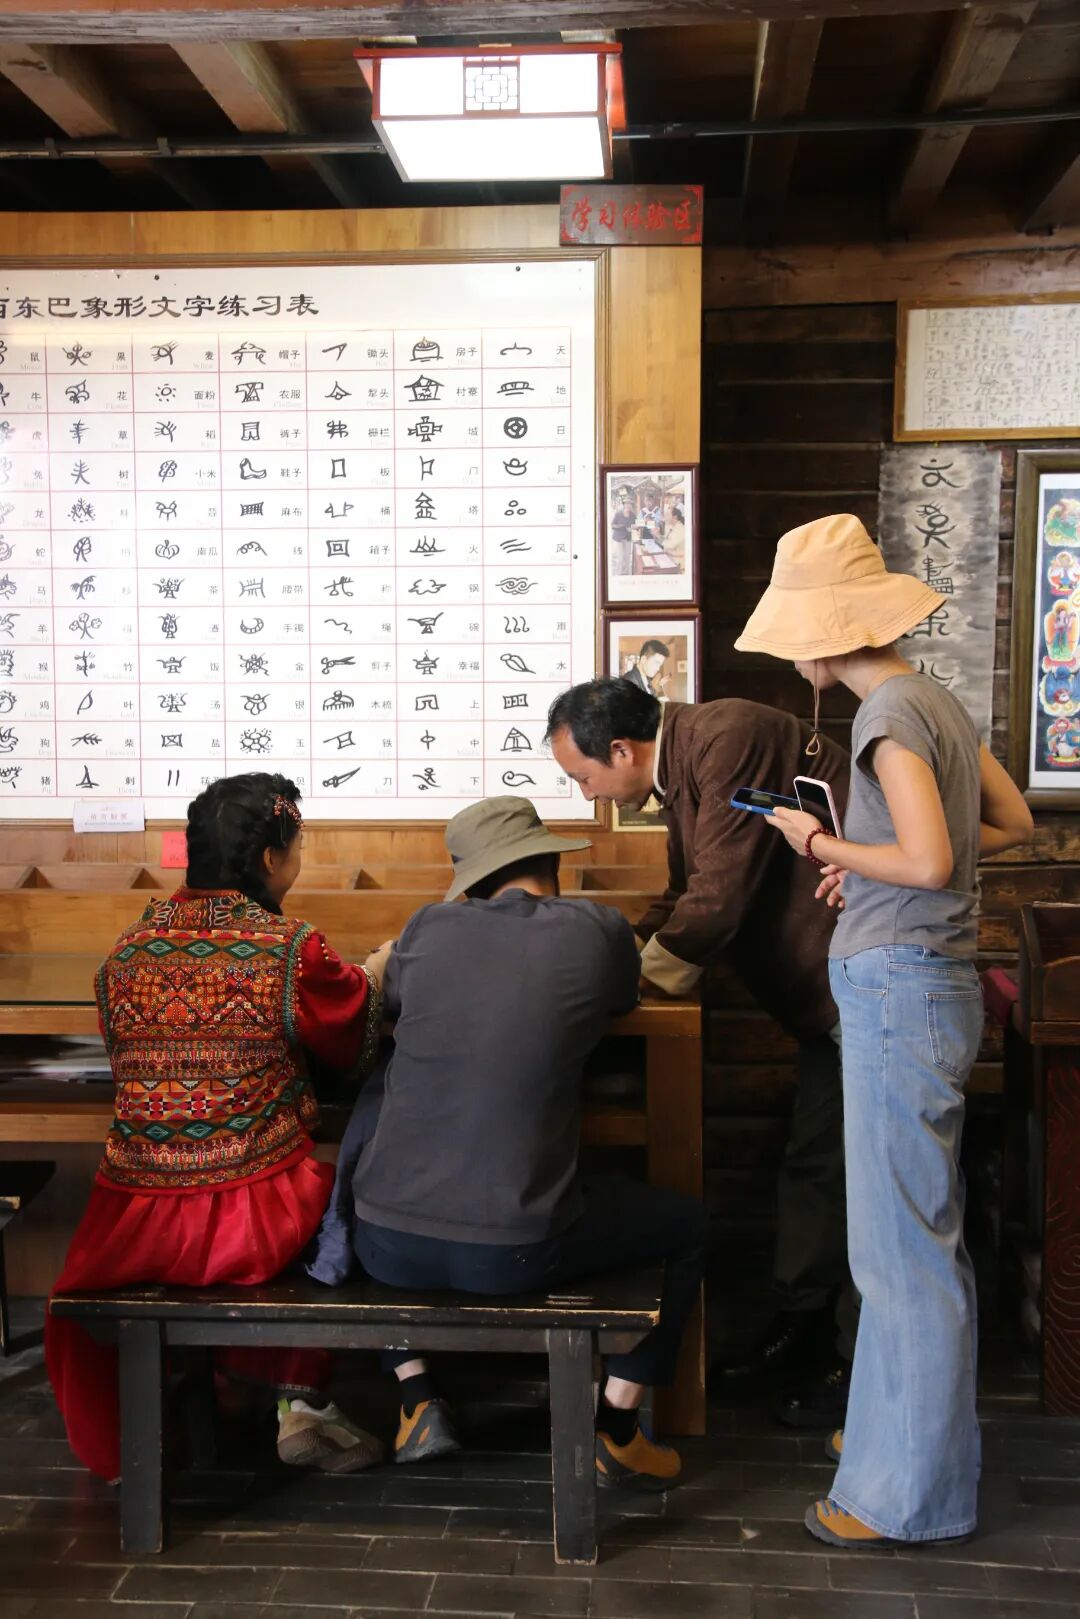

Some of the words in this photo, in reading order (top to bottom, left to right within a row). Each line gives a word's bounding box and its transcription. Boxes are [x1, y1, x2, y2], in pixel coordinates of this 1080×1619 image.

[572, 194, 691, 232] 学习体验区
[278, 350, 300, 360] 帽子
[456, 346, 478, 358] 房子
[556, 346, 566, 356] 天
[116, 390, 128, 400] 花
[194, 390, 216, 400] 面粉
[278, 388, 300, 400] 衣服
[556, 386, 566, 394] 地
[30, 392, 42, 402] 牛
[118, 430, 128, 440] 草
[280, 428, 302, 438] 裤子
[468, 426, 478, 436] 城
[556, 426, 566, 434] 日
[196, 468, 216, 478] 小米
[280, 468, 302, 478] 鞋子
[380, 466, 390, 476] 板
[468, 466, 478, 476] 门
[556, 464, 566, 474] 月
[118, 470, 128, 480] 树
[34, 508, 44, 518] 龙
[280, 508, 302, 516] 麻布
[468, 506, 478, 516] 塔
[556, 504, 566, 514] 星
[196, 546, 218, 556] 南瓜
[468, 544, 478, 554] 火
[556, 544, 566, 552] 风
[37, 586, 46, 596] 马
[208, 586, 218, 594] 茶
[468, 584, 480, 592] 锅
[557, 583, 567, 592] 云
[38, 624, 48, 634] 羊
[124, 662, 132, 672] 竹
[295, 662, 304, 672] 金
[458, 662, 480, 670] 幸福
[556, 660, 568, 670] 水
[40, 700, 50, 710] 鸡
[124, 700, 134, 710] 叶
[294, 700, 304, 710] 银
[370, 700, 392, 710] 木梳
[470, 700, 480, 708] 上
[40, 738, 50, 748] 狗
[296, 738, 304, 748] 玉
[382, 738, 392, 748] 铁
[470, 738, 480, 748] 中
[40, 776, 52, 786] 猪
[295, 777, 305, 786] 贝
[384, 778, 392, 786] 刀
[470, 776, 480, 786] 下
[557, 775, 566, 785] 海
